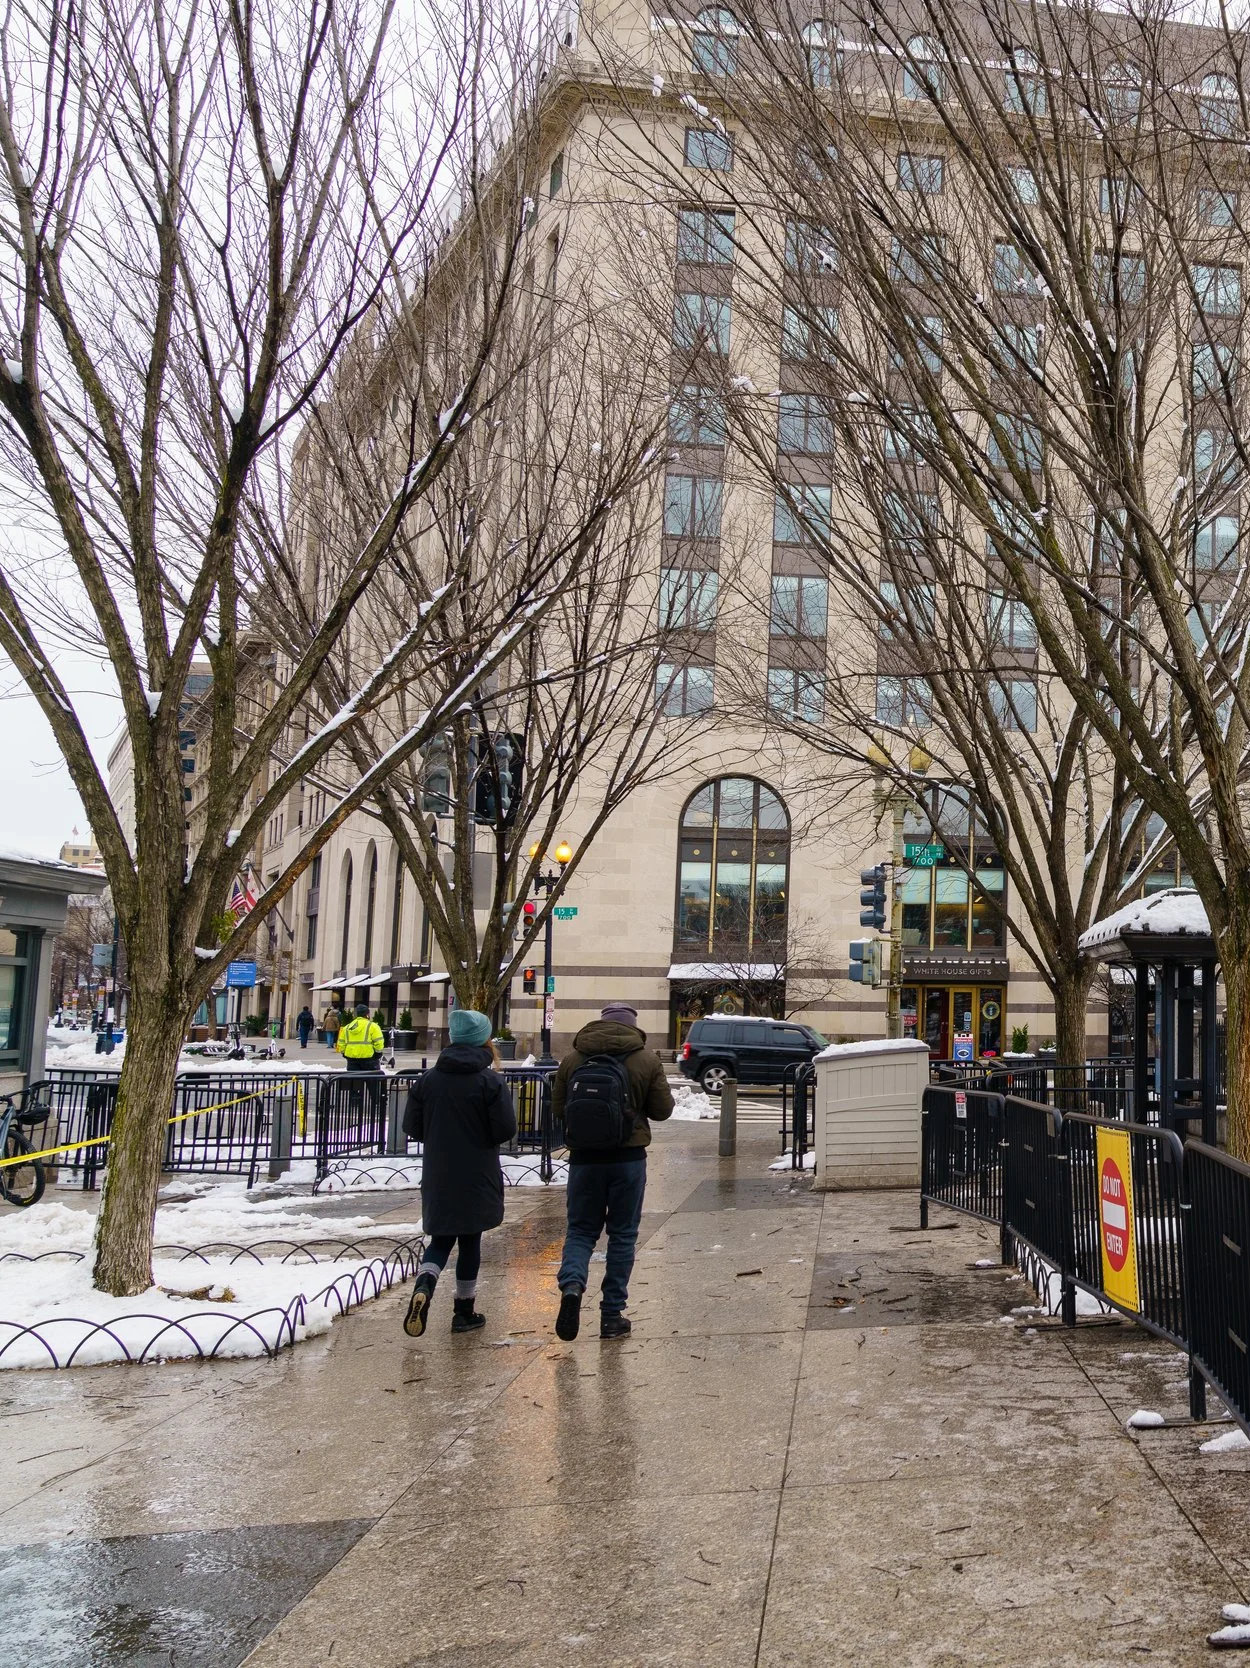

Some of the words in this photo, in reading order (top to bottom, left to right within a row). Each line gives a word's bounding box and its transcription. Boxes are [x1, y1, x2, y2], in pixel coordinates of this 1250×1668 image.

[969, 968, 992, 976] GIFTS
[1103, 1174, 1110, 1195] DO
[1109, 1176, 1121, 1198] NOT
[1106, 1231, 1124, 1257] ENTER
